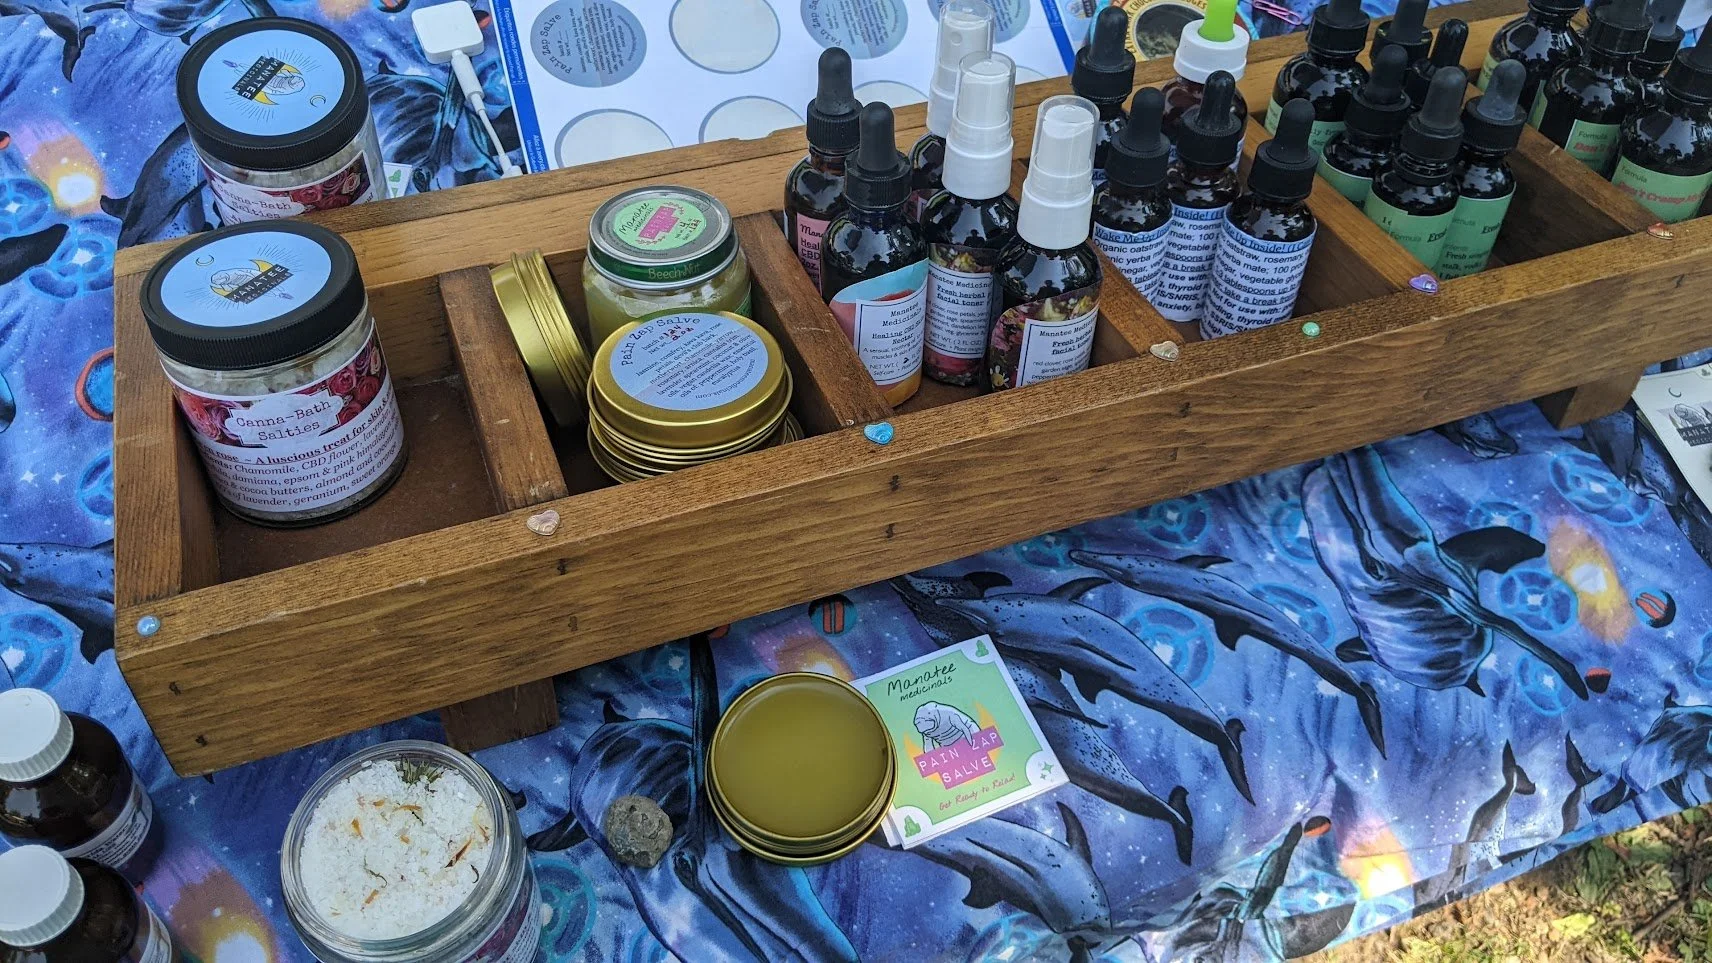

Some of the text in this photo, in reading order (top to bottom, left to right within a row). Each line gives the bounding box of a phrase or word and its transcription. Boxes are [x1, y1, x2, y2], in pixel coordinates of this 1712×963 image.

[812, 13, 821, 28] Zap
[540, 14, 573, 74] Pain Zap Salve
[821, 29, 842, 46] Pain
[217, 183, 292, 210] Canna-Bath
[231, 200, 281, 219] Salties
[1174, 207, 1209, 220] Inside!
[1095, 226, 1120, 242] Wake
[1122, 234, 1138, 243] Me
[1199, 232, 1215, 241] 100
[1234, 232, 1286, 252] Up Inside!
[801, 248, 820, 260] CBD
[1094, 238, 1128, 253] Organic
[1167, 239, 1210, 252] vegetable
[1226, 239, 1261, 262] oatstraw,
[1126, 254, 1151, 265] yerba
[1445, 251, 1467, 259] Fresh
[1172, 261, 1206, 272] a break
[1243, 261, 1269, 275] mate;
[1273, 266, 1289, 274] 100
[1168, 271, 1186, 281] use
[1240, 272, 1283, 285] vegetable
[937, 284, 986, 299] Fresh herbal
[1168, 281, 1202, 292] thyroid
[1224, 275, 1289, 295] tablespoons up
[937, 293, 959, 304] facial
[1224, 286, 1278, 306] take a break
[1223, 298, 1237, 309] for
[1238, 305, 1257, 315] use
[1258, 306, 1281, 315] with:
[1207, 319, 1223, 336] high
[1237, 314, 1271, 326] thyroid
[621, 316, 701, 366] Pain Zap Salve
[641, 339, 660, 351] batch
[1052, 340, 1074, 348] Fresh
[1052, 346, 1076, 355] facial
[236, 400, 332, 427] Canna-Bath
[255, 457, 265, 465] A
[268, 448, 321, 464] luscious
[323, 434, 351, 452] treat
[352, 422, 367, 437] for
[367, 405, 385, 424] skin
[259, 421, 320, 441] Salties
[234, 464, 299, 476] Chamomile,
[301, 456, 327, 470] CBD
[328, 441, 363, 464] flower,
[232, 473, 282, 486] damiana,
[283, 469, 320, 485] epsom
[322, 467, 331, 476] &
[333, 455, 356, 474] pink
[239, 485, 268, 496] cocoa
[270, 483, 313, 496] butters,
[315, 467, 355, 489] almond
[356, 457, 373, 471] and
[243, 493, 291, 506] lavender,
[293, 484, 350, 506] geranium,
[351, 468, 376, 486] sweet
[887, 661, 957, 697] Manatee
[900, 675, 953, 702] medicinals
[918, 732, 998, 772] PAIN ZAP
[941, 756, 992, 783] SALVE
[939, 799, 952, 811] Get
[955, 790, 978, 805] Ready
[982, 785, 990, 793] to
